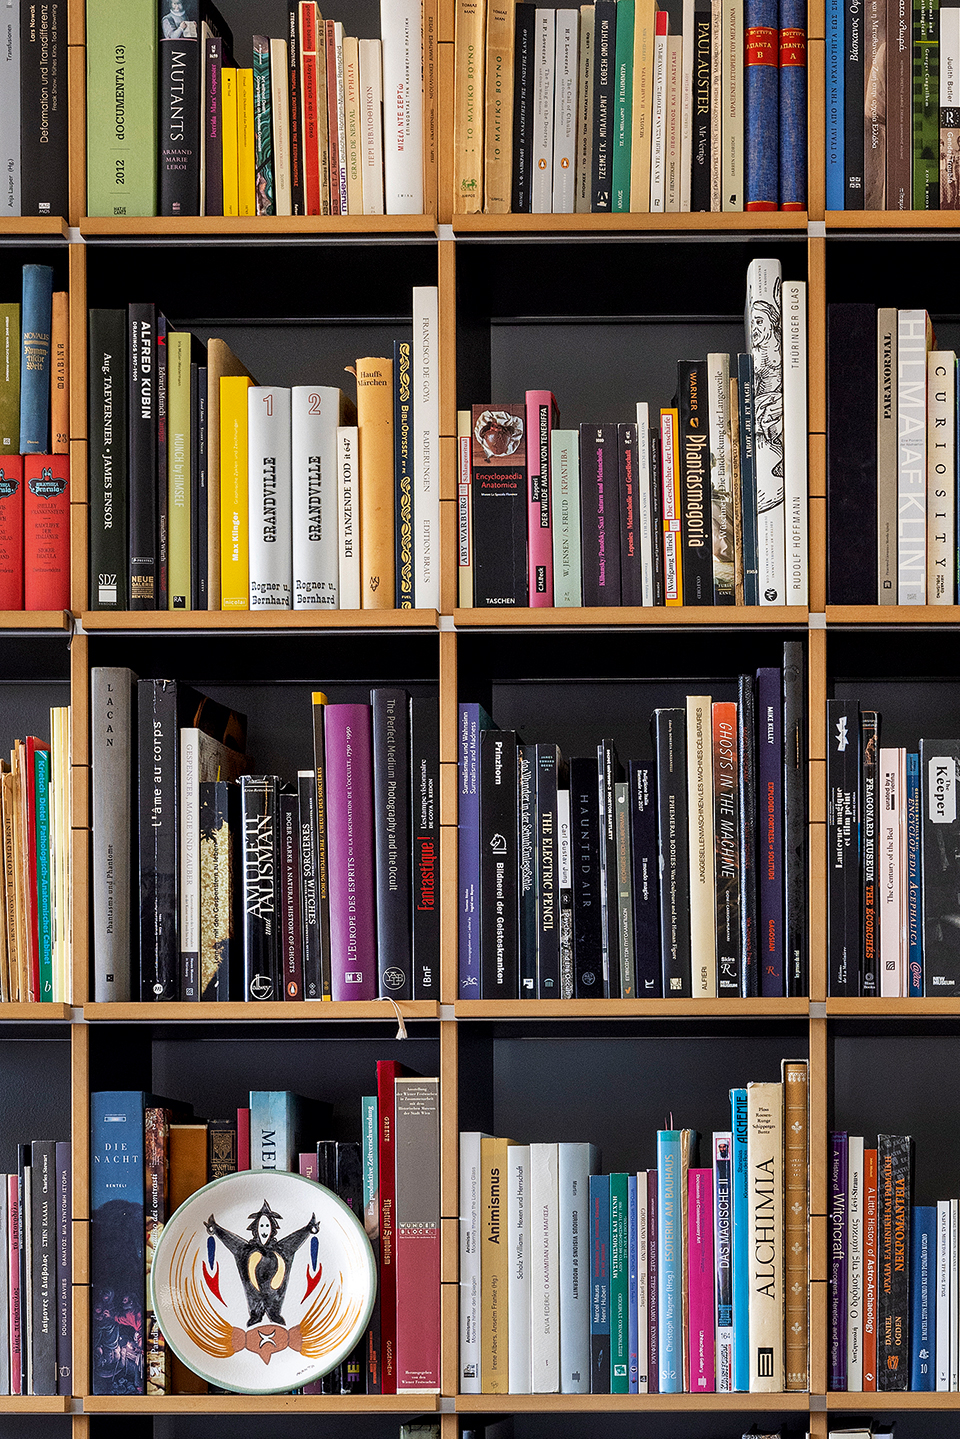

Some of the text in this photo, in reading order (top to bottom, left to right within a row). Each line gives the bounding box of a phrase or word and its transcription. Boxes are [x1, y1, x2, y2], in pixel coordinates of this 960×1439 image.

[40, 4, 49, 144] Deformation und Transdifferenz
[116, 44, 126, 141] dOCUMENTA (13)
[171, 50, 187, 142] MUTANTS
[697, 23, 709, 115] PAUL AUSTER
[116, 160, 125, 185] 2012
[141, 321, 151, 419] ALFRED KUBIN
[791, 287, 799, 368] THÜRINGER GLAS
[263, 394, 274, 416] 1
[308, 394, 320, 415] 2
[690, 371, 698, 411] WARNER
[883, 332, 892, 419] PARANORMAL
[102, 454, 113, 529] JAMES ENSOR
[263, 457, 277, 544] GRANDVILLE
[308, 456, 322, 542] GRANDVILLE
[476, 473, 523, 481] Encyclopaedia
[686, 434, 710, 548] Phantasmagoria
[935, 366, 947, 568] CURIOSITY
[460, 496, 469, 565] ABY WARBURG
[792, 496, 801, 589] RUDOLF HOFFMANN
[252, 594, 289, 606] Bernhard
[152, 721, 162, 828] l'âme au corps
[719, 721, 735, 878] GHOSTS IN THE MACHINE
[936, 766, 945, 817] Keeper
[261, 814, 274, 914] TALISMAN
[542, 812, 553, 931] THE ELECTRIC PENCIL
[866, 778, 874, 882] FRAGONARD MUSEUM
[94, 1155, 139, 1163] NACHT
[105, 1143, 127, 1151] DIE
[738, 1096, 748, 1143] ALCHEMIE
[488, 1168, 500, 1245] Animismus
[664, 1153, 674, 1261] ESOTERIK AM BAUHAUS
[755, 1156, 776, 1300] ALCHIMIA
[833, 1193, 846, 1260] Witchcraft
[895, 1178, 905, 1272] ΝΕΚΡΟΜΑΝΤΕΙΑ
